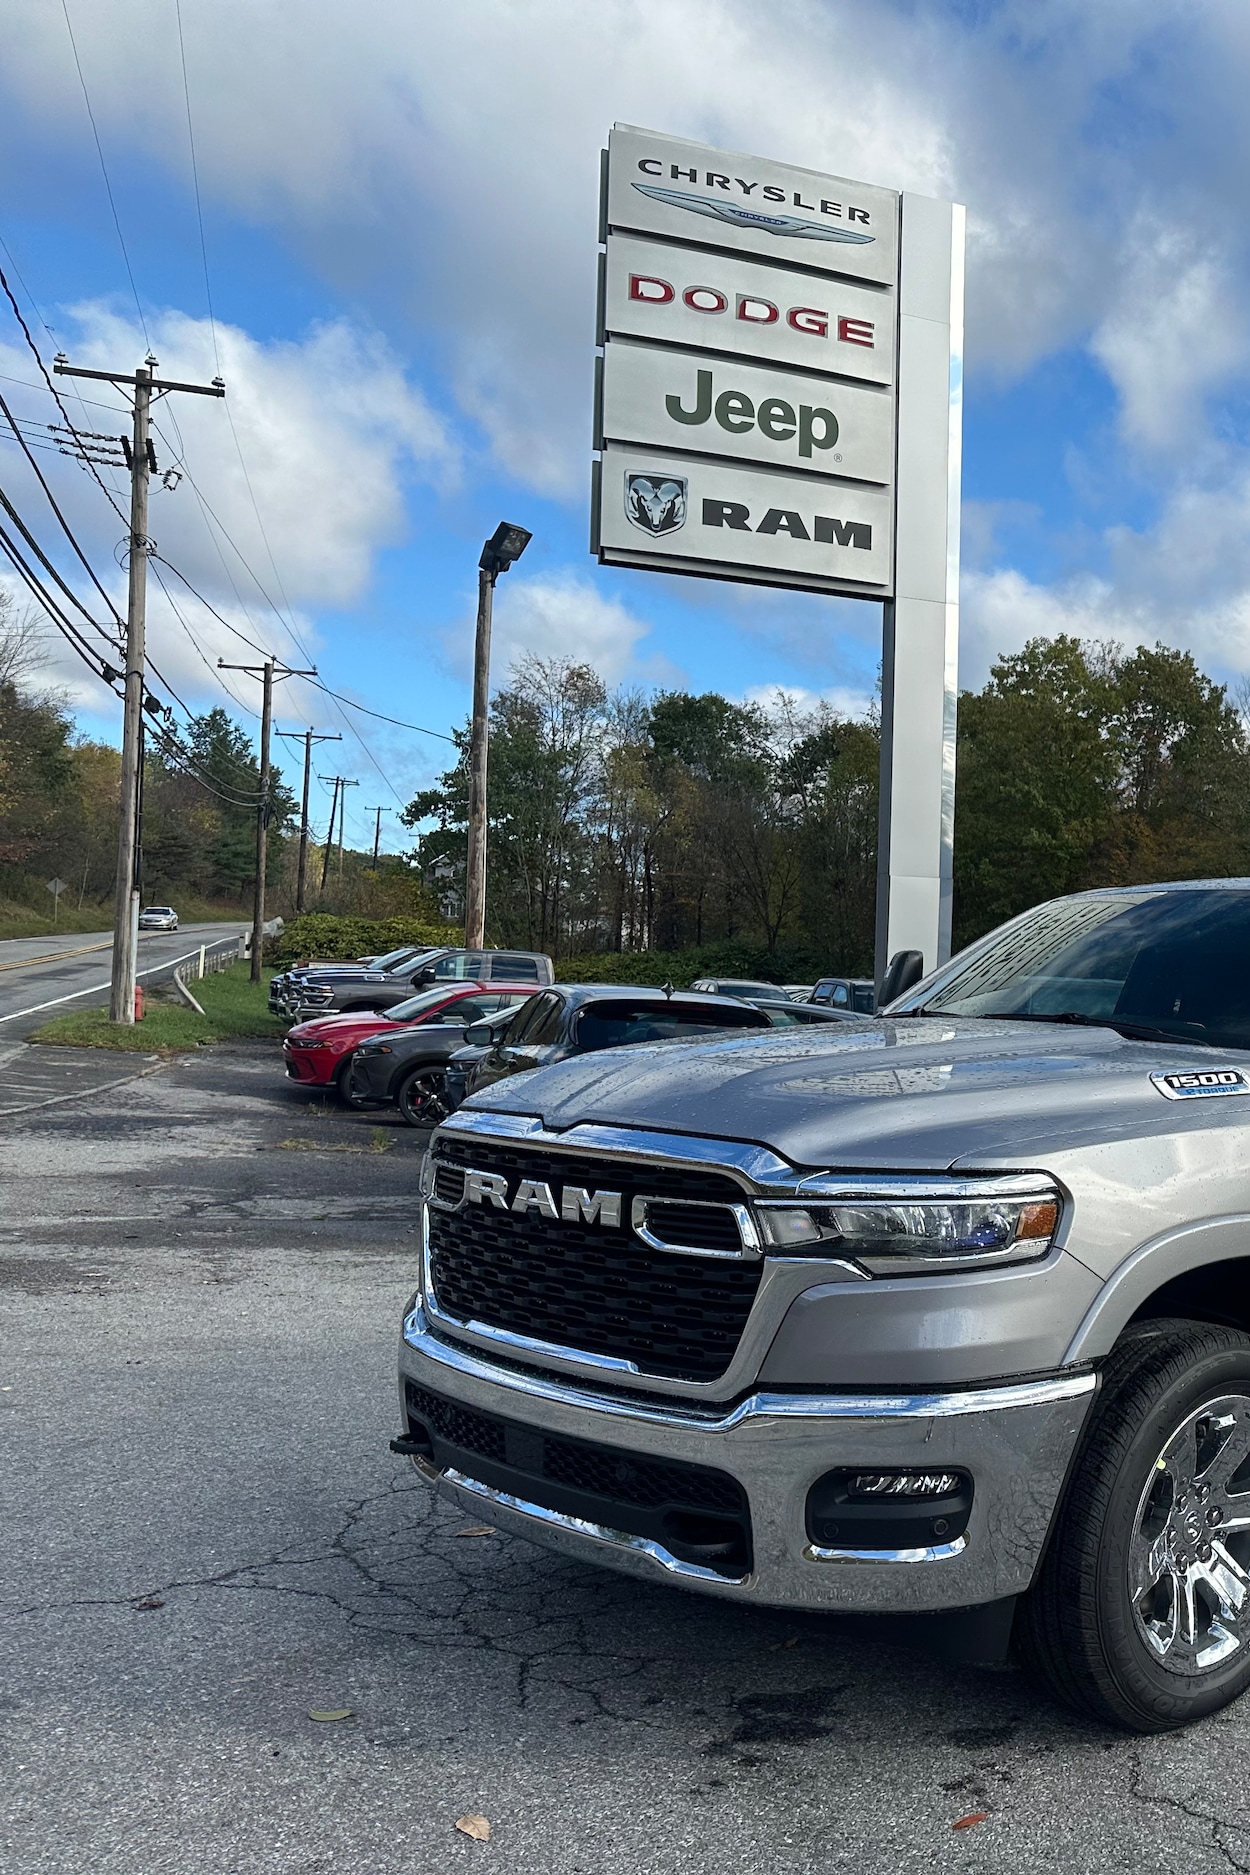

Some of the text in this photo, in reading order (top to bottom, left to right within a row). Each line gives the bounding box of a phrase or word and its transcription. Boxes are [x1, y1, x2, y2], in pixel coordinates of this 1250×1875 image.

[638, 158, 872, 225] CHRYSLER
[628, 273, 875, 348] DODGE
[665, 370, 839, 458] Jeep
[702, 498, 873, 551] RAM
[1167, 1072, 1238, 1089] 1500
[465, 1168, 622, 1228] RAM
